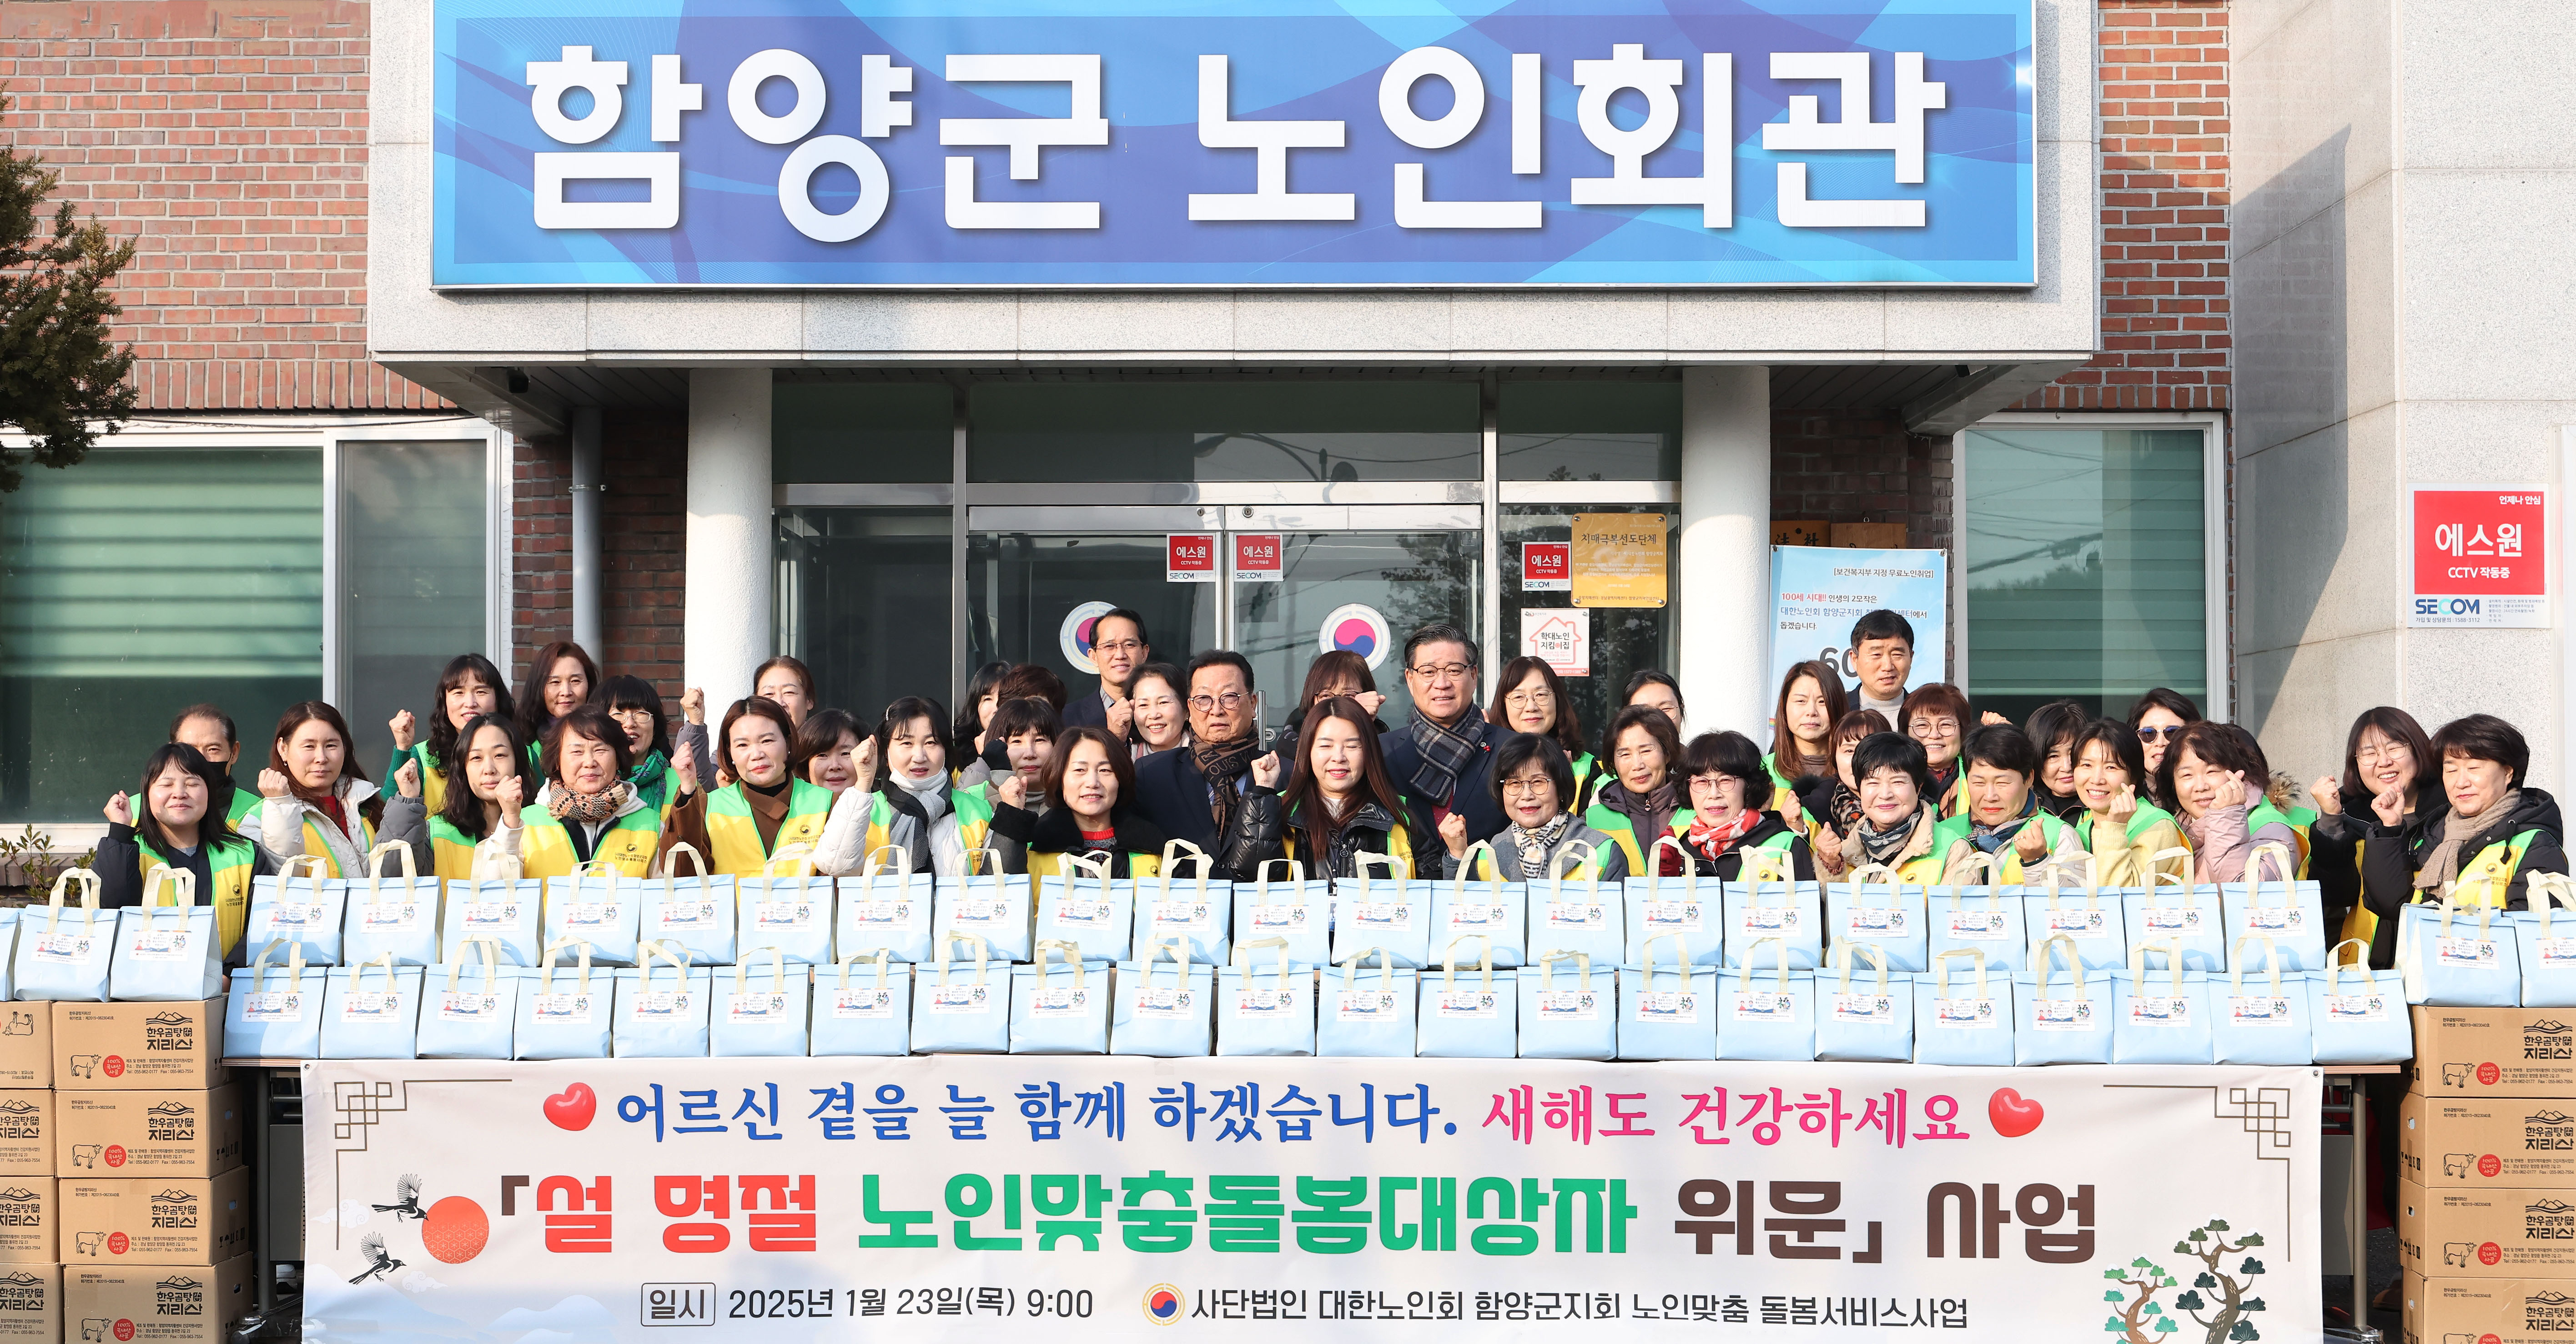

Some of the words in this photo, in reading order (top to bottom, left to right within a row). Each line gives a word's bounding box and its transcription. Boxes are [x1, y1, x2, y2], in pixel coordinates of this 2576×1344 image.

[526, 45, 1109, 243] 함양군
[1188, 43, 1947, 231] 노인회관
[2499, 496, 2523, 504] 언제나
[2525, 496, 2541, 505] 안심
[1581, 533, 1656, 545] 치매극복선도단체
[2435, 524, 2521, 557] 에스원
[1177, 547, 1206, 557] 에스원
[1243, 546, 1273, 557] 에스원
[1532, 555, 1561, 566] 에스원
[1889, 570, 1933, 578] 무료노인취업]
[2448, 567, 2478, 578] CCTV
[2480, 567, 2510, 578] 작동중
[1782, 593, 1803, 602] 100세
[1807, 594, 1826, 602] 시대!!
[1781, 607, 1820, 616] 대한노인회
[1824, 608, 1863, 618] 함양군지회
[2415, 599, 2480, 615] SECOM
[1208, 756, 1239, 776] OUIS
[146, 1027, 184, 1037] 한우곰탕
[147, 1038, 193, 1050] 지리산
[2524, 1036, 2561, 1046] 한우곰탕
[2524, 1048, 2572, 1059] 지리산
[618, 1082, 782, 1142] 어르신
[808, 1082, 918, 1140] 곁을
[939, 1085, 994, 1139] 늘
[1014, 1081, 1124, 1142] 함께
[1149, 1082, 1457, 1143] 하겠습니다.
[1482, 1084, 1655, 1145] 새해도
[1679, 1087, 1970, 1148] 건강하세요
[148, 1117, 186, 1128] 한우곰탕
[149, 1129, 194, 1141] 지리산
[2525, 1126, 2563, 1137] 한우곰탕
[2526, 1138, 2574, 1150] 지리산
[151, 1205, 189, 1215] 한우곰탕
[152, 1216, 197, 1228] 지리산
[502, 1175, 612, 1253] 「설
[654, 1175, 816, 1253] 명절
[859, 1170, 1637, 1256] 노인맞춤돌봄대상자
[1675, 1179, 1882, 1263] 위문」
[1927, 1182, 2094, 1264] 사업
[2526, 1215, 2564, 1226] 한우곰탕
[2526, 1227, 2574, 1239] 지리산
[0, 1287, 34, 1298] 한우곰탕
[156, 1291, 194, 1302] 한우곰탕
[0, 1299, 44, 1310] 지리산
[650, 1289, 704, 1319] 일시
[730, 1289, 833, 1318] 2025년
[847, 1289, 886, 1316] 1월
[897, 1287, 1014, 1316] 23일(목)
[1028, 1289, 1092, 1318] 9:00
[157, 1303, 202, 1315] 지리산
[1192, 1289, 1306, 1319] 사단법인
[1320, 1290, 1462, 1320] 대한노인회
[1475, 1292, 1620, 1320] 함양군지회
[1632, 1294, 1749, 1323] 노인맞춤
[1760, 1296, 1967, 1328] 돌봄서비스사업
[2526, 1307, 2564, 1317] 한우곰탕
[2526, 1319, 2574, 1331] 지리산
